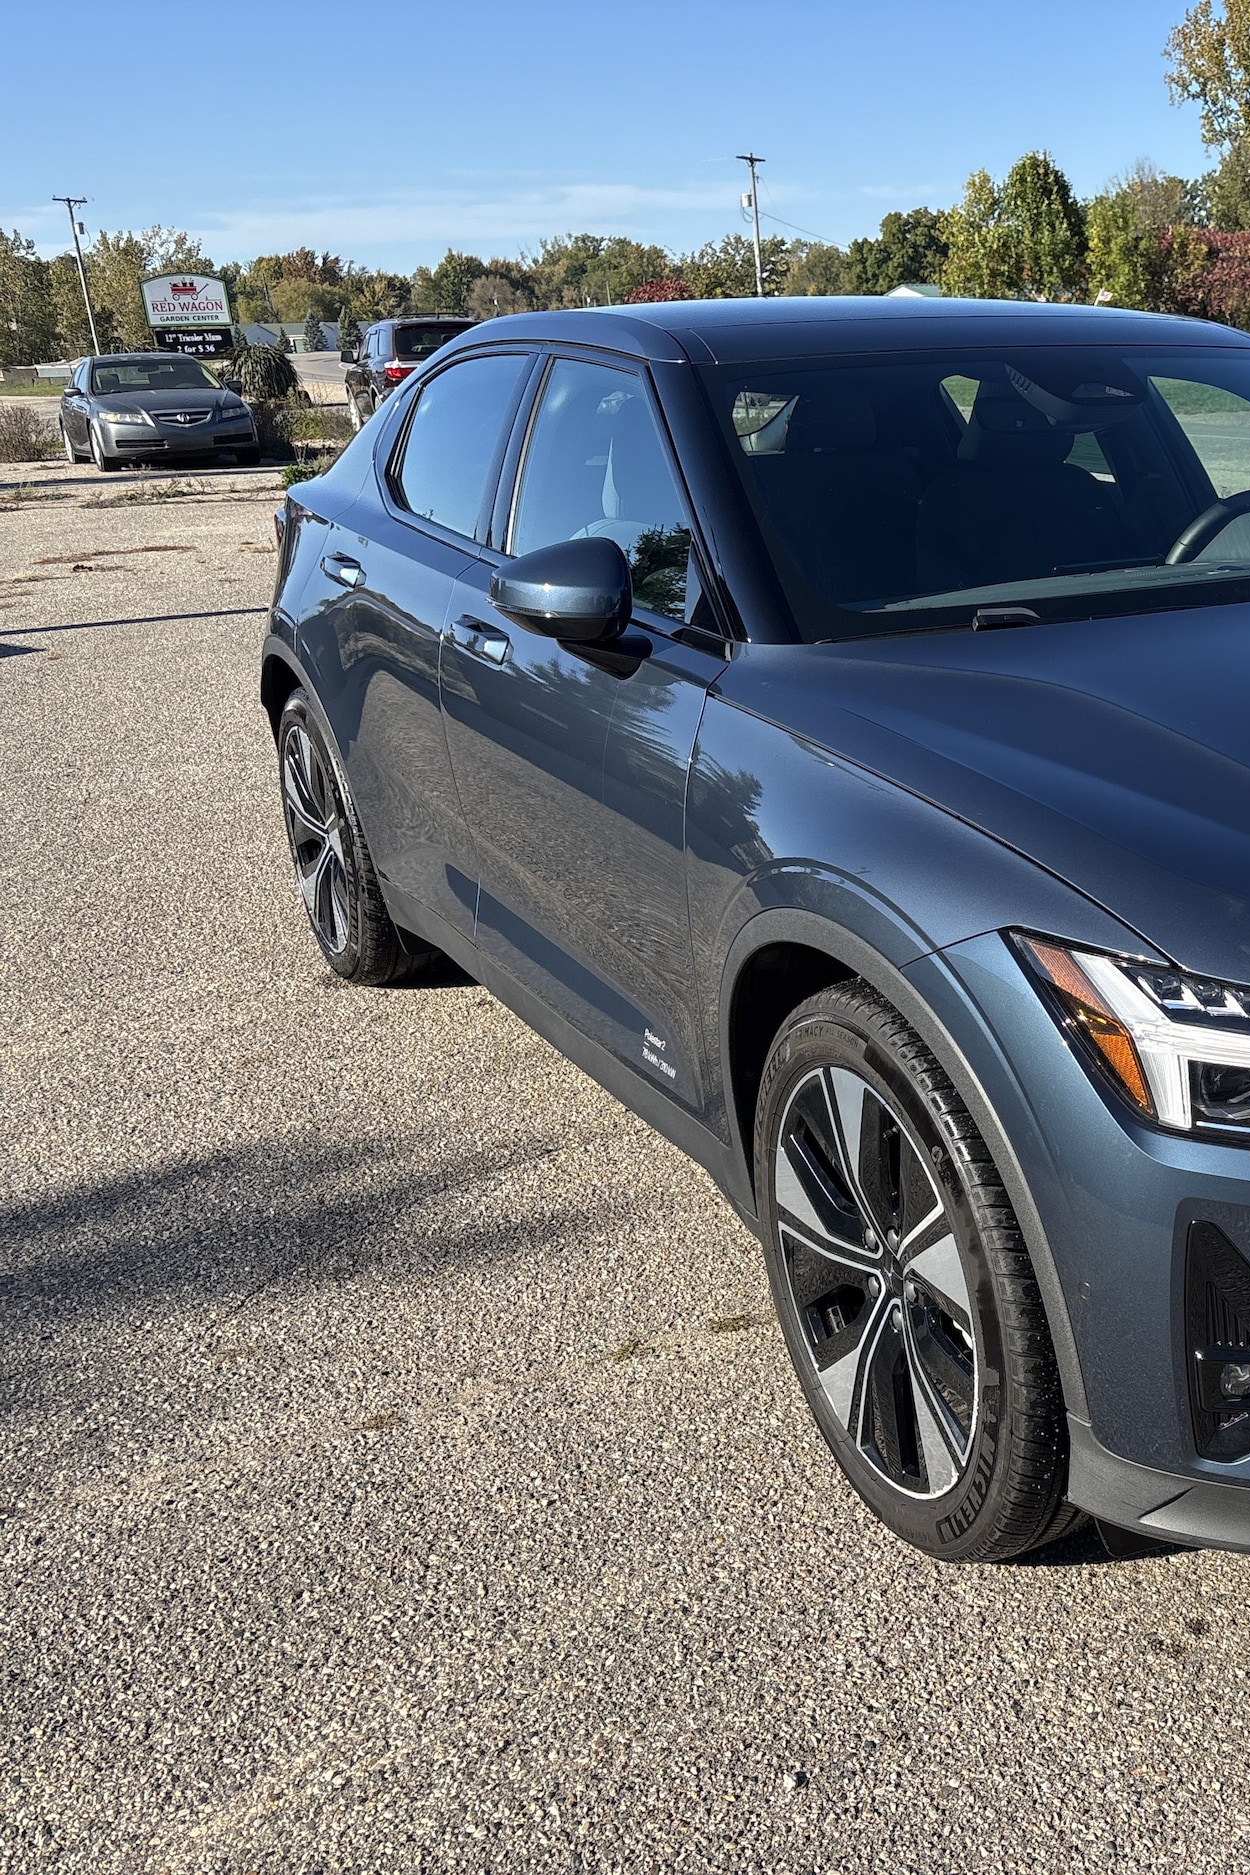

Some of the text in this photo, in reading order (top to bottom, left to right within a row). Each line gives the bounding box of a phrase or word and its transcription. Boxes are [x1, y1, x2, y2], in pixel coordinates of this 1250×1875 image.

[152, 302, 223, 312] RED WAGON
[165, 334, 176, 342] 12"
[177, 334, 203, 342] Tricolor
[198, 345, 203, 353] $
[205, 344, 215, 352] 36
[940, 1431, 995, 1543] MICHELIN
